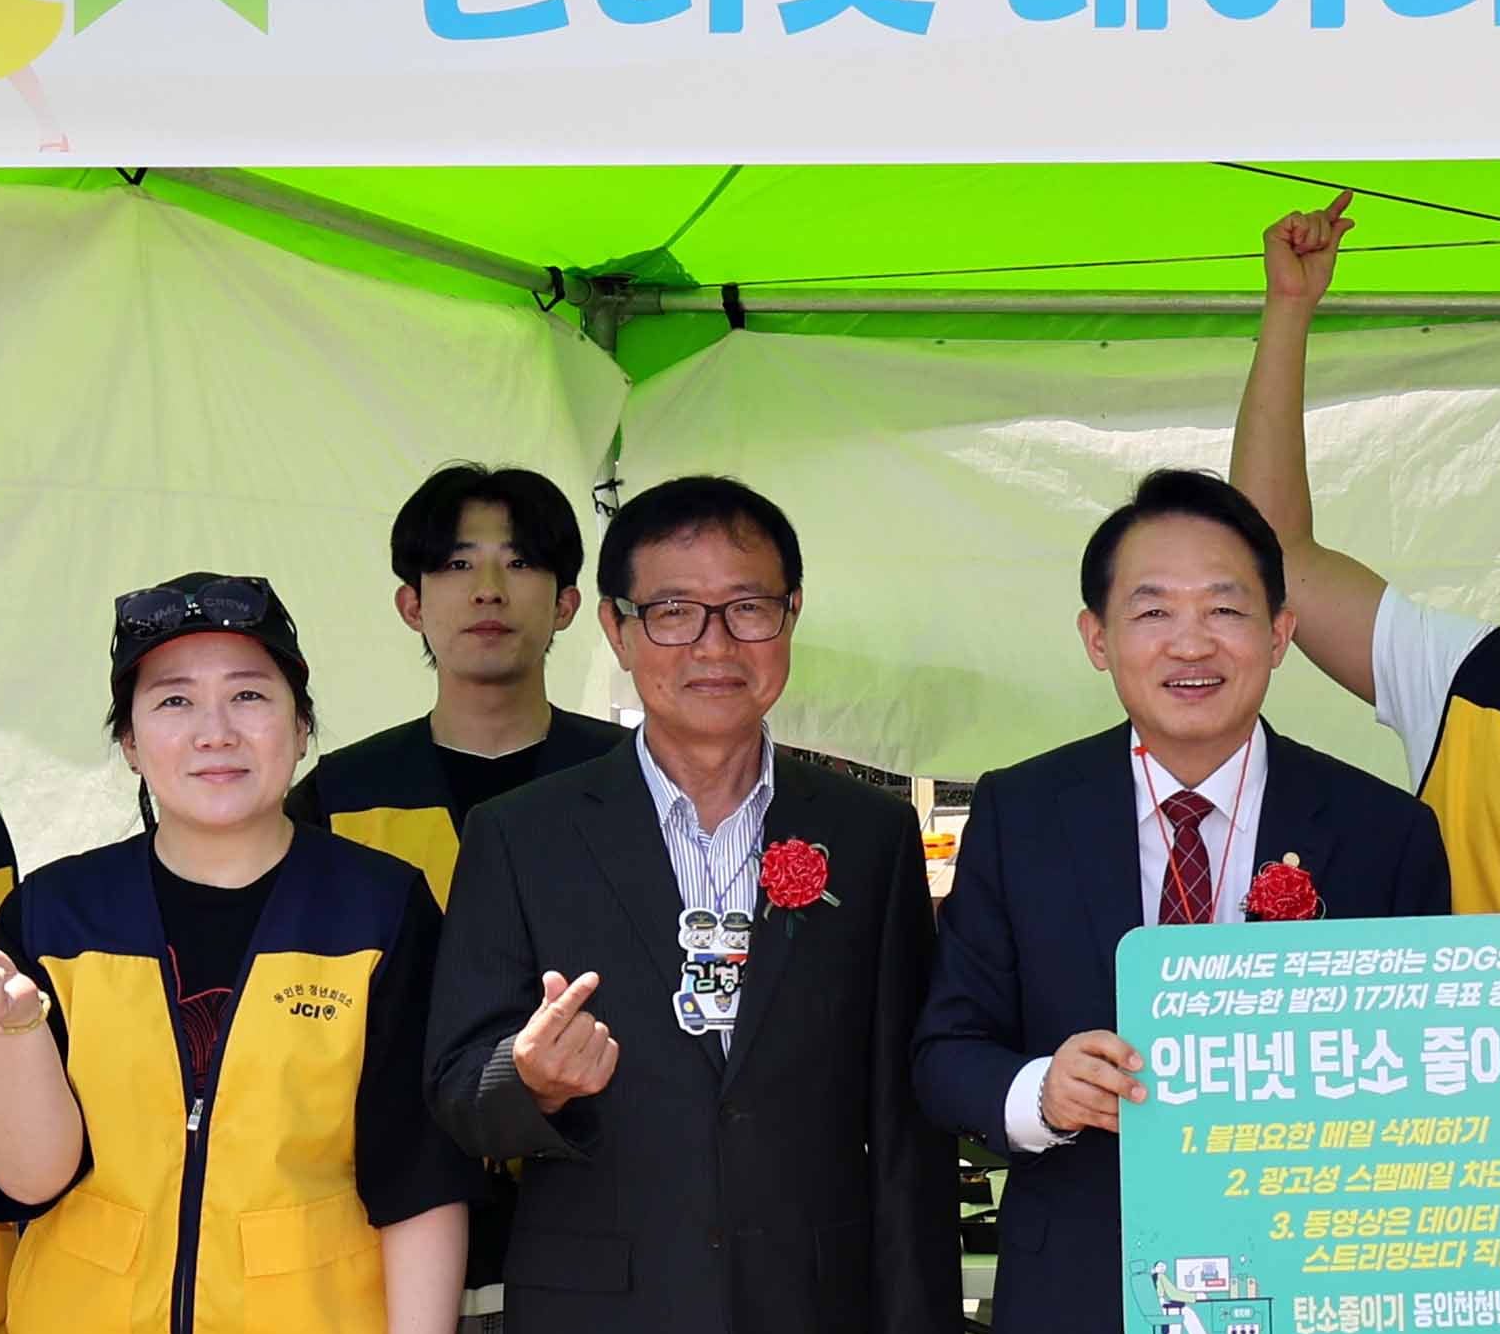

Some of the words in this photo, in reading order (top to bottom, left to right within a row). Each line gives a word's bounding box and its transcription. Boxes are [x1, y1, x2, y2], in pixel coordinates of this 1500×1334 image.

[1161, 952, 1275, 983] UN에서도
[1282, 948, 1427, 979] 적극권장하는
[289, 1002, 322, 1019] JCI
[1151, 988, 1285, 1019] (지속가능한
[1288, 985, 1349, 1016] 발전)
[1353, 982, 1429, 1012] 17가지
[1433, 980, 1483, 1009] 목표
[1150, 1030, 1297, 1107] 인터넷
[1311, 1027, 1408, 1099] 탄소
[1180, 1125, 1198, 1154] 1.
[1205, 1121, 1314, 1156] 불필요한
[1318, 1119, 1375, 1151] 메일
[1380, 1116, 1491, 1149] 삭제하기
[1224, 1169, 1250, 1197] 2.
[1257, 1165, 1338, 1197] 광고성
[1344, 1162, 1454, 1193] 스팸메일
[1269, 1212, 1295, 1241] 3.
[1302, 1207, 1414, 1240] 동영상은
[1416, 1204, 1500, 1237] 데이터
[1302, 1240, 1468, 1274] 스트리밍보다
